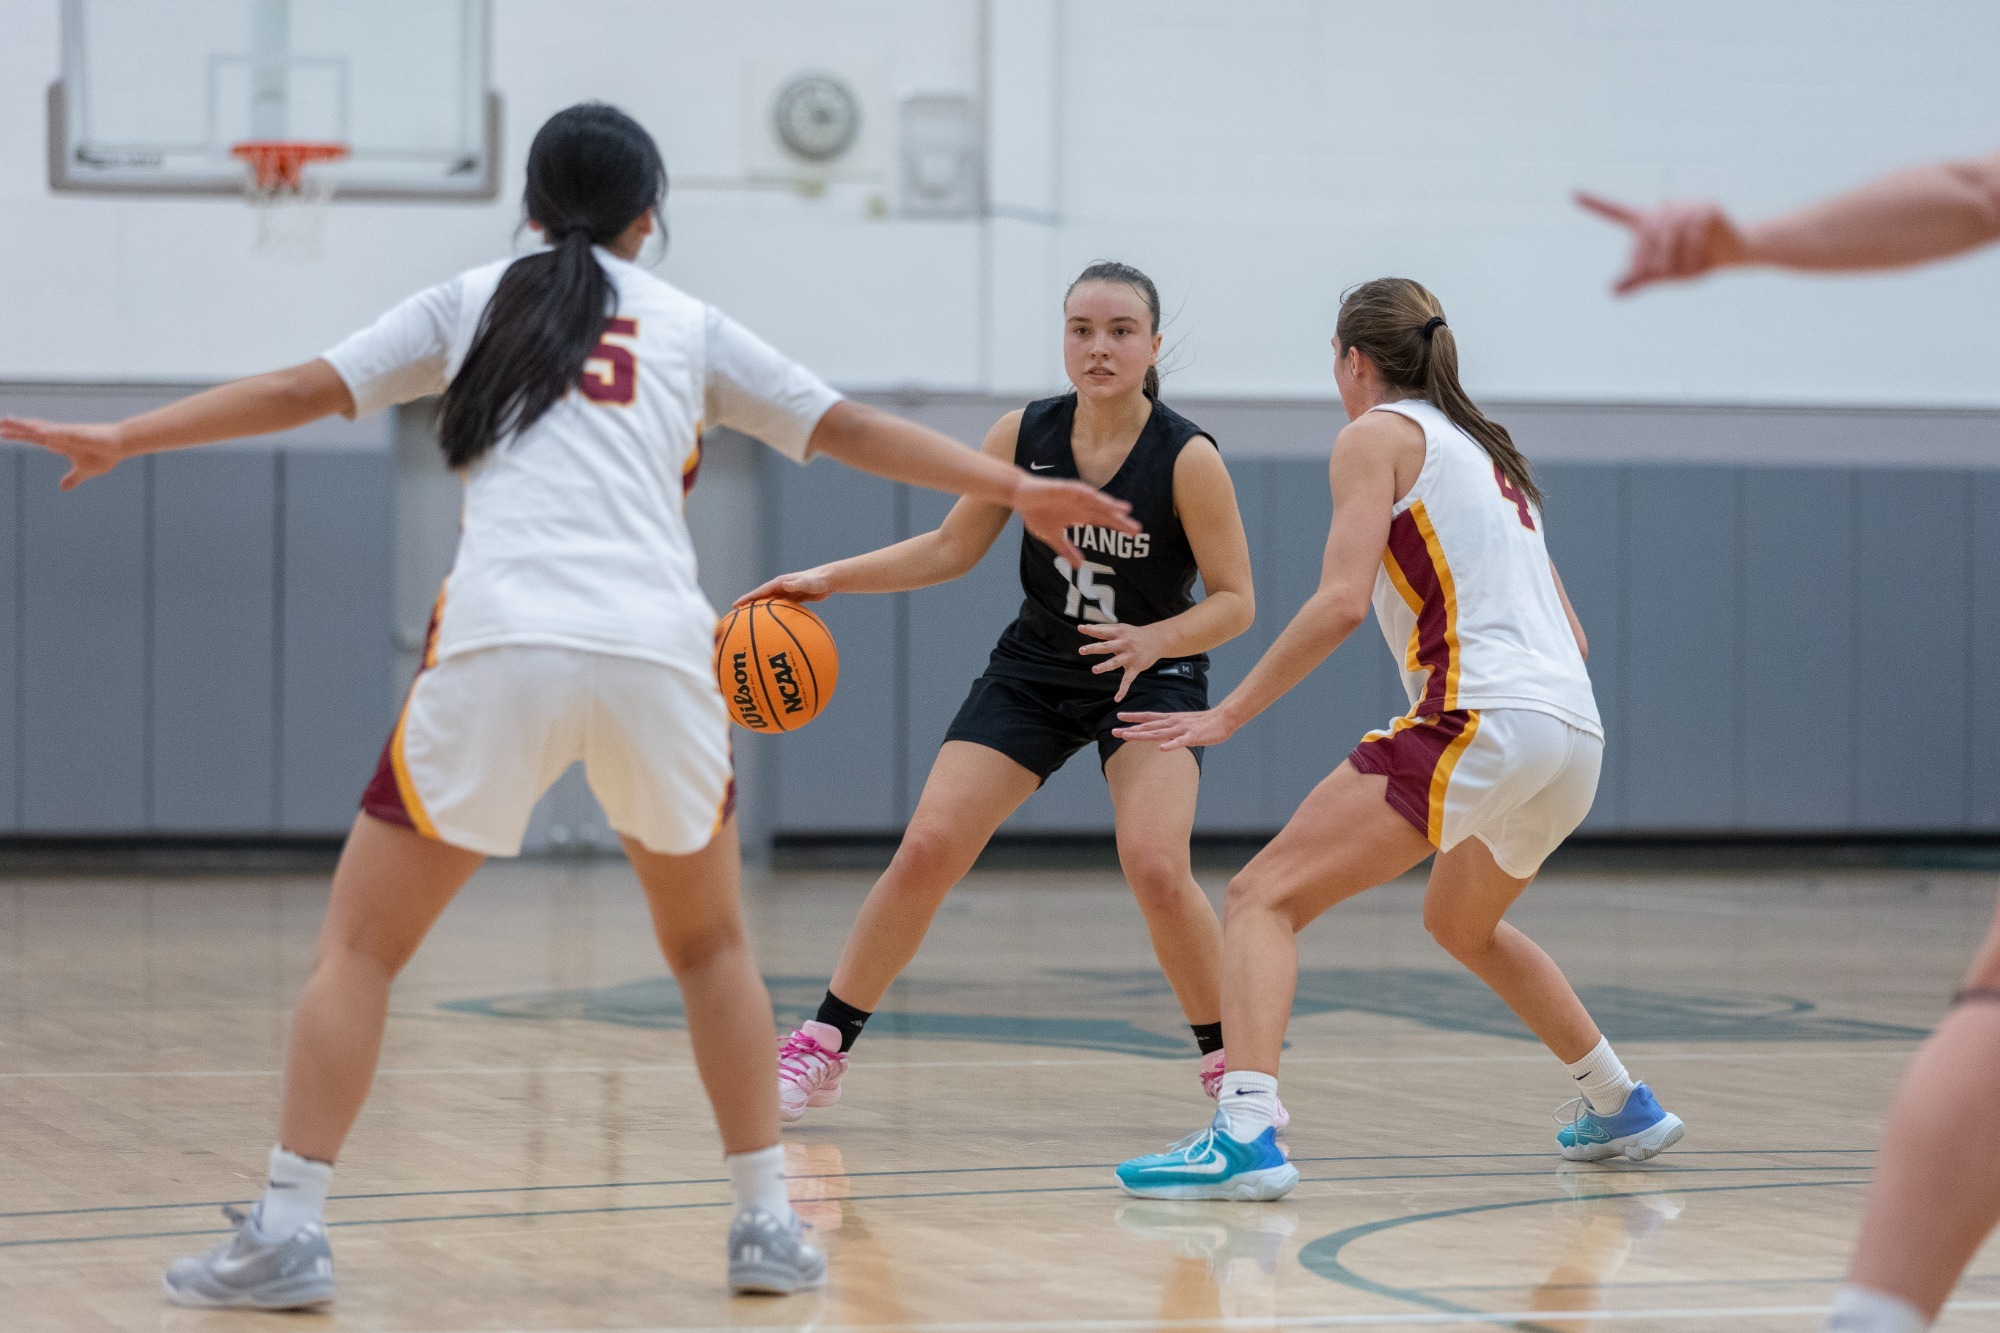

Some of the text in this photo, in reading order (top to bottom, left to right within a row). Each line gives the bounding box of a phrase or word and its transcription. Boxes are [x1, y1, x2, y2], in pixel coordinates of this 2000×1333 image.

[564, 316, 639, 408] 5
[1062, 522, 1151, 559] TANGS
[1053, 555, 1119, 625] 15
[733, 651, 769, 729] Wilson
[768, 651, 804, 715] NCAA
